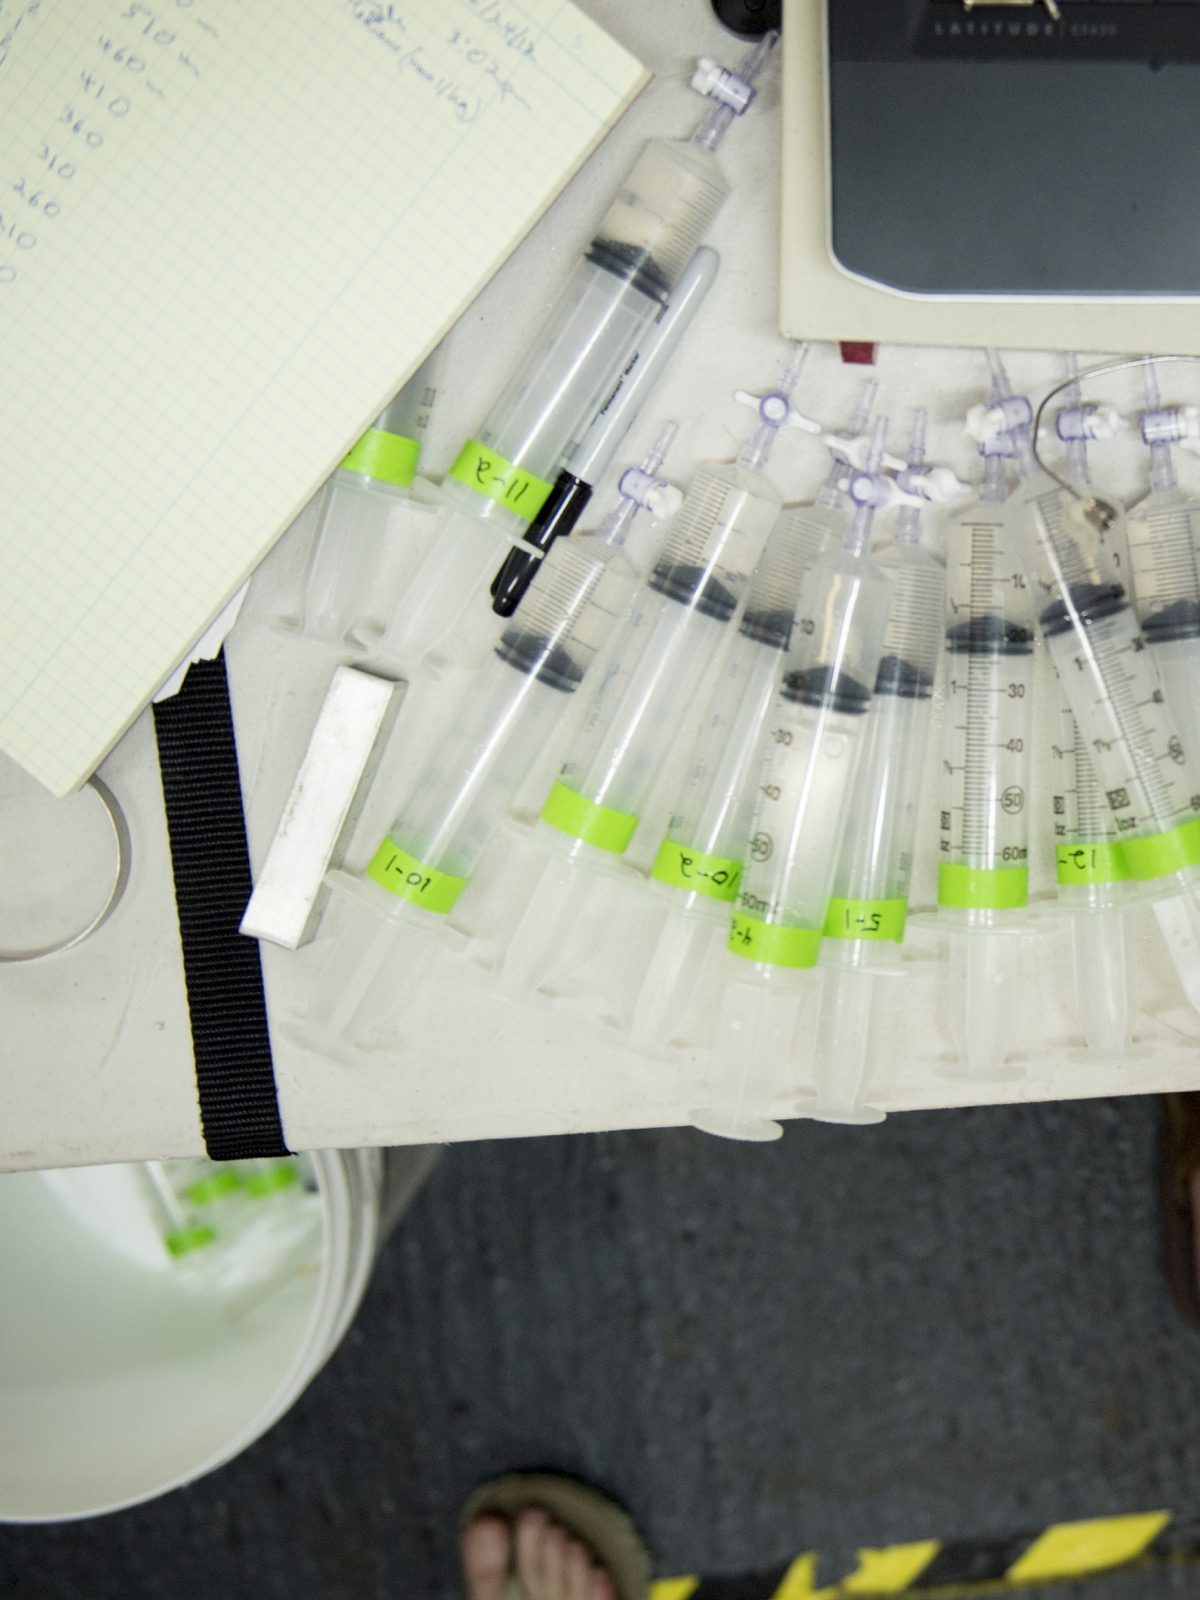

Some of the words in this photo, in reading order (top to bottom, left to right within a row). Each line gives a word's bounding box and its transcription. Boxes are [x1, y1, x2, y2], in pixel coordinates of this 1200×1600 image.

[933, 22, 1053, 37] LATITUDE
[80, 68, 131, 117] 410
[12, 176, 61, 218] 260
[1008, 683, 1026, 699] 30
[1006, 738, 1024, 753] 40
[1004, 792, 1023, 808] 50
